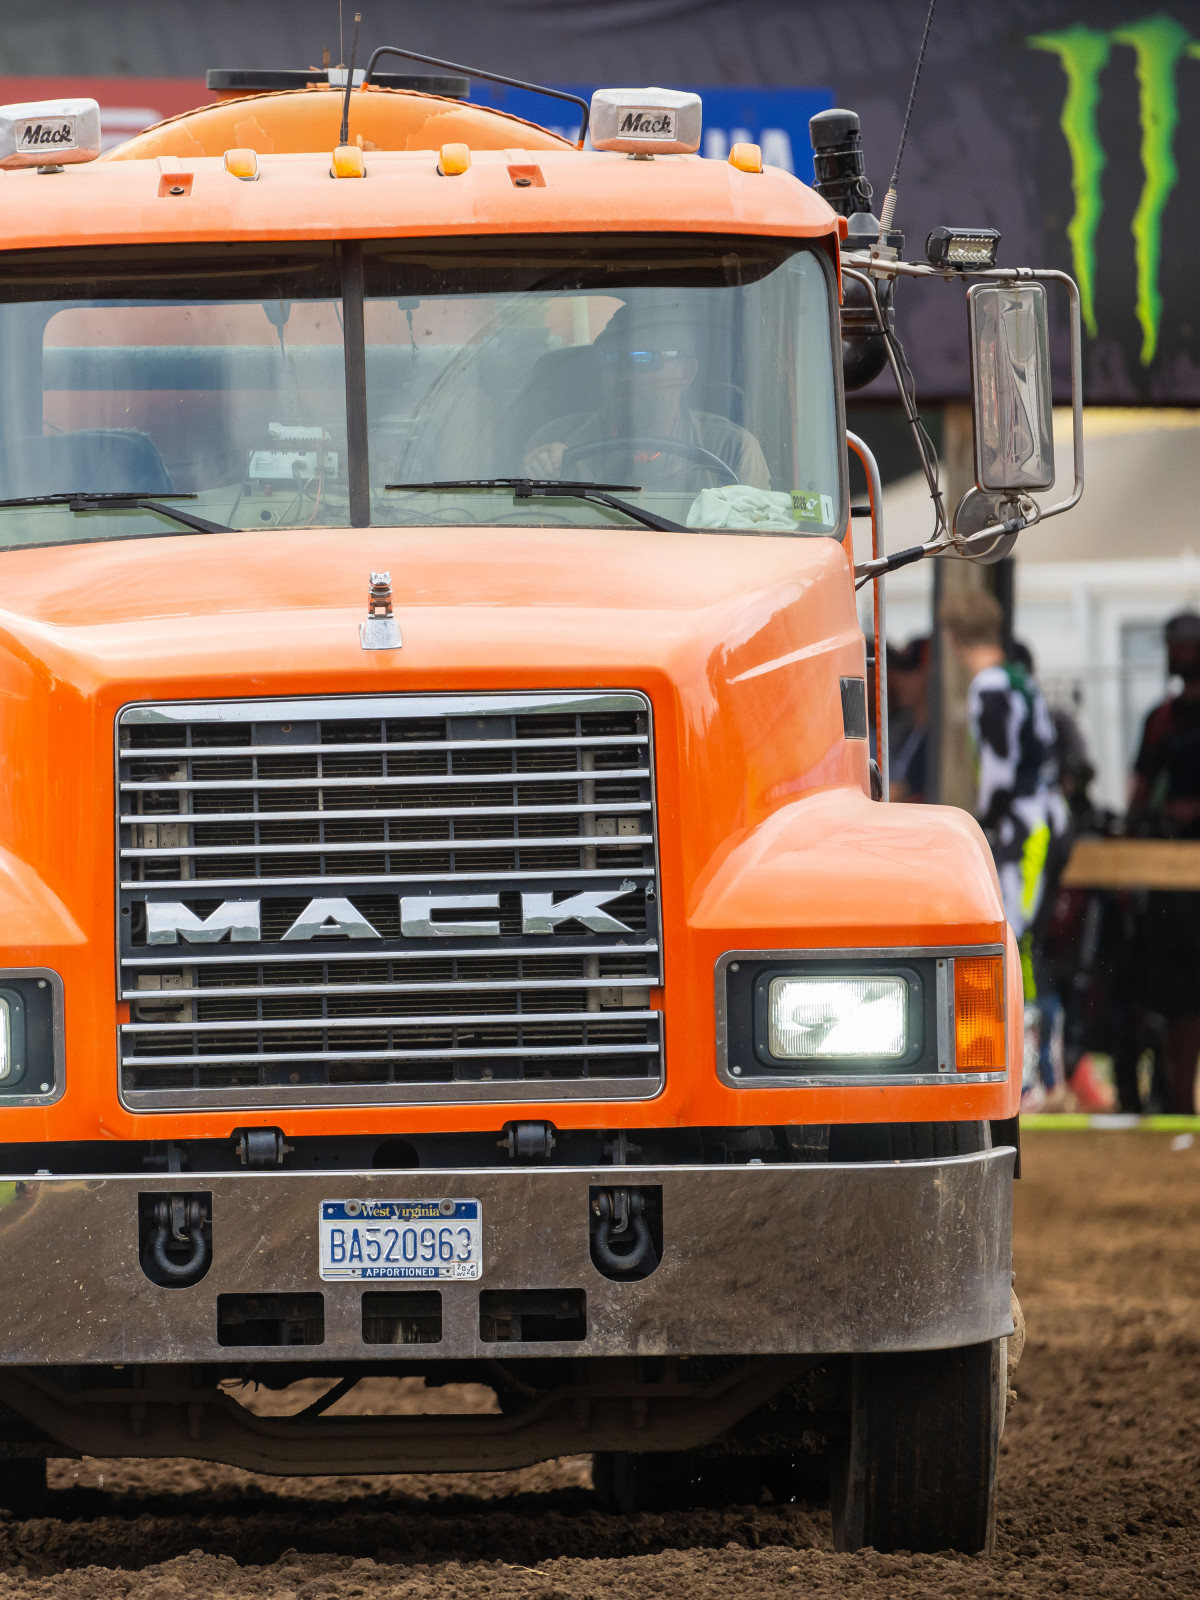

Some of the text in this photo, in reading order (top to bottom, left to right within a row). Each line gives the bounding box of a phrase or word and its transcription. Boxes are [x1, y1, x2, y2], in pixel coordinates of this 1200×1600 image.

[620, 112, 673, 134] Mack
[21, 124, 73, 145] Mack
[145, 889, 637, 945] MACK
[362, 1203, 440, 1219] West Virginia
[330, 1226, 472, 1263] BA520963
[366, 1267, 435, 1277] APPORTIONED
